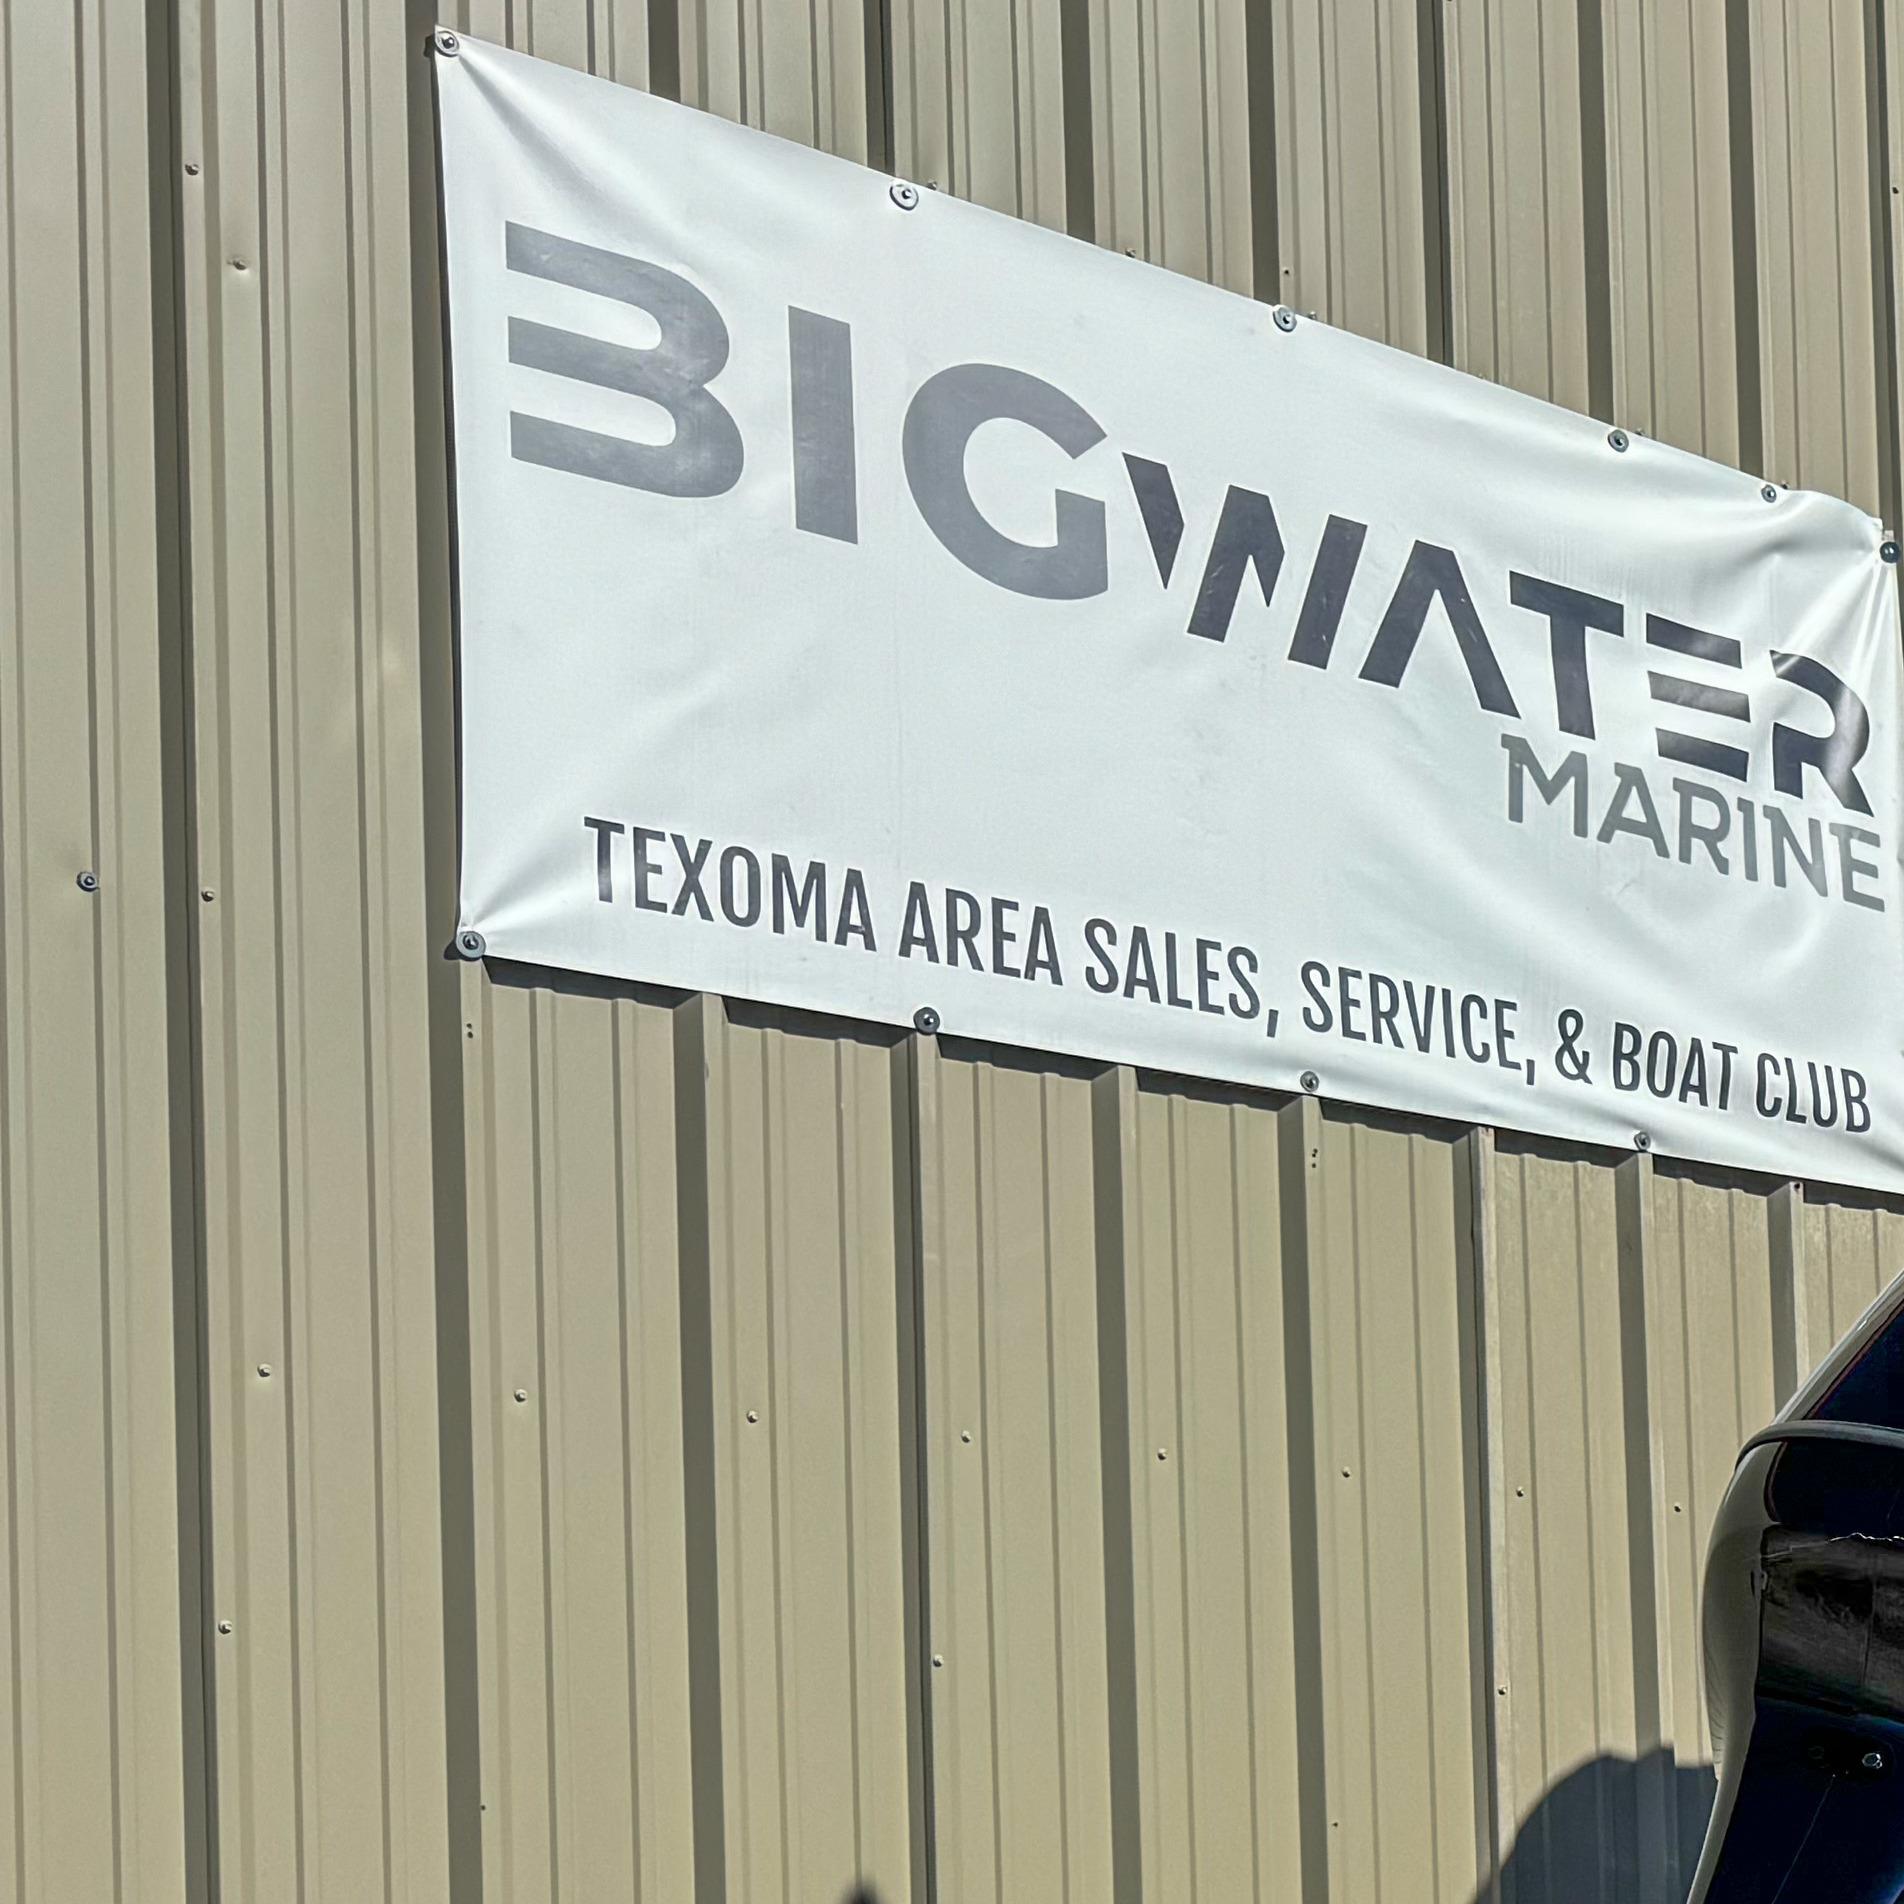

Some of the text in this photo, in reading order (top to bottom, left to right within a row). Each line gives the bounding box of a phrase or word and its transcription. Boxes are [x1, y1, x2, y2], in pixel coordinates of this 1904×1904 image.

[504, 220, 1875, 817] BIGWATER
[584, 816, 1871, 1133] TEXOMA AREA SALES, SERVICE, & BOAT CLUB
[1500, 733, 1885, 912] MARINE
